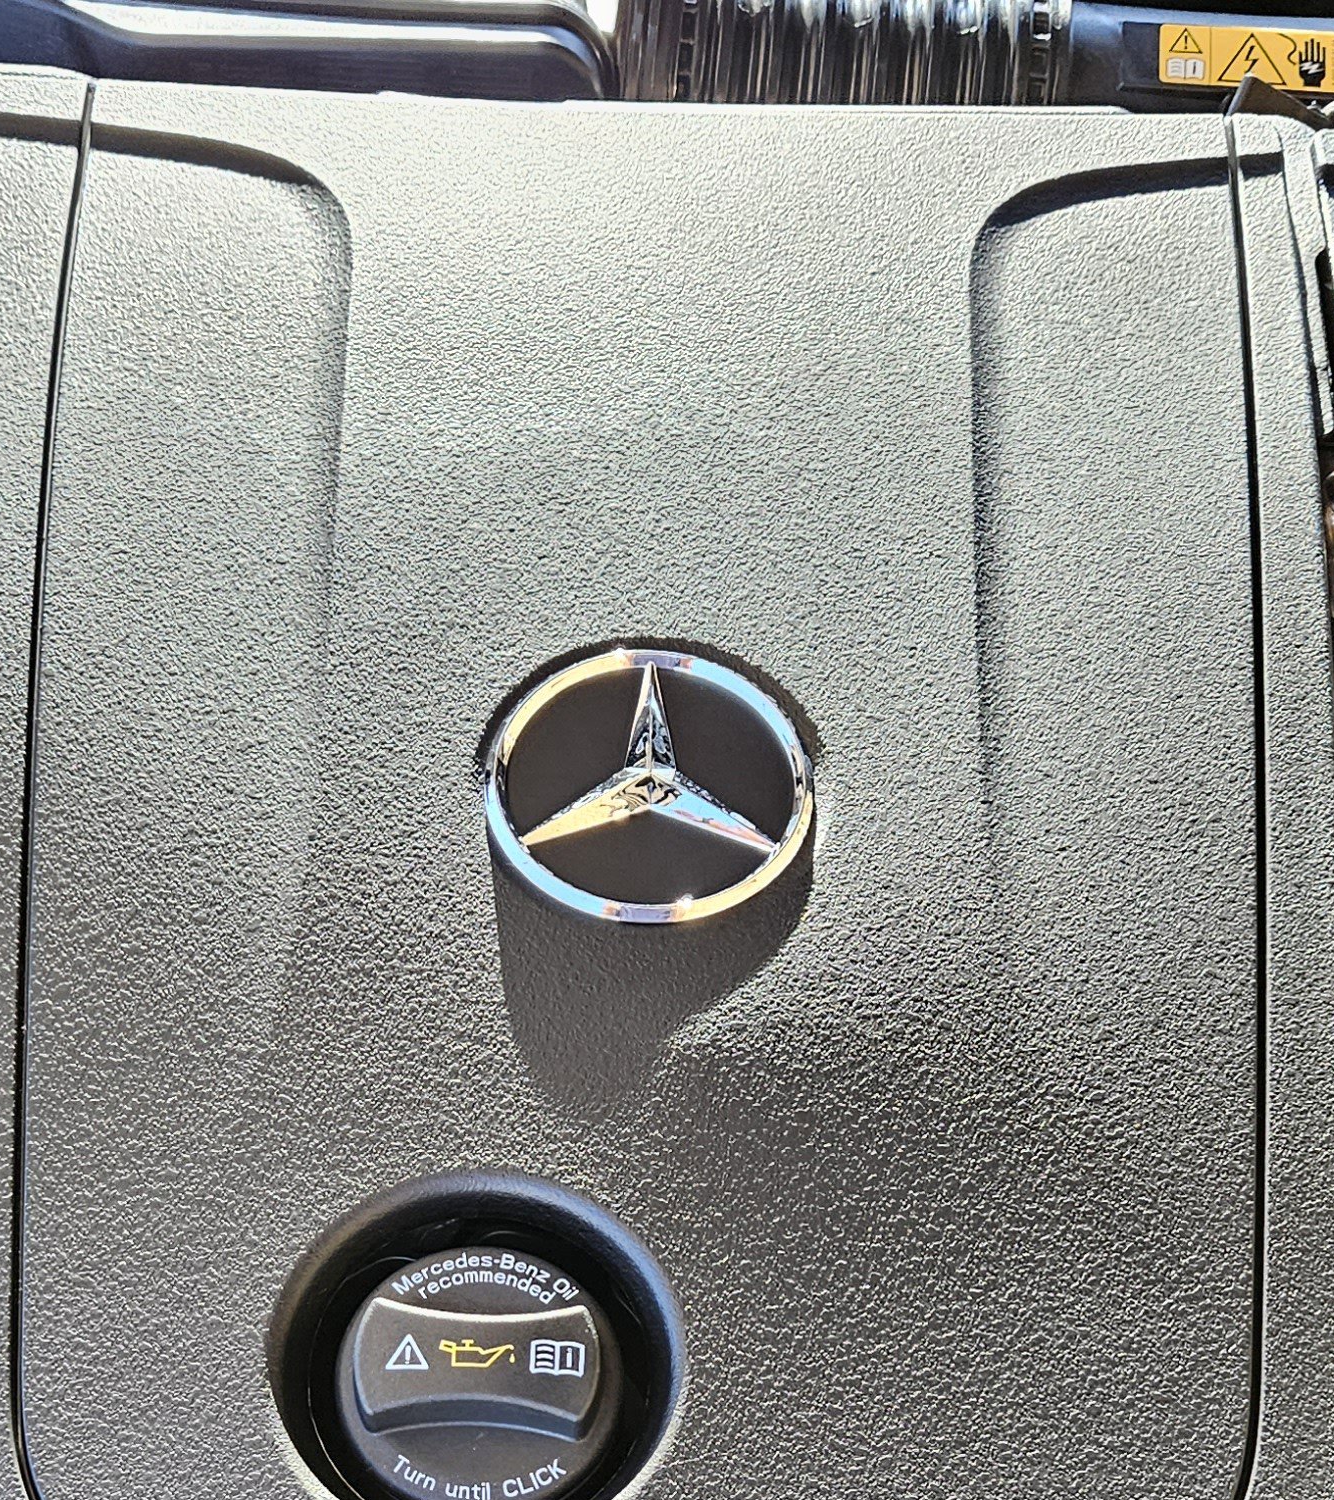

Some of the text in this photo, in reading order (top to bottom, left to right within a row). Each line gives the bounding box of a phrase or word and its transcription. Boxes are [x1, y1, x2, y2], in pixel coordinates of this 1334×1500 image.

[391, 1252, 580, 1302] Mercedes-Benz Oil
[417, 1269, 557, 1305] recommended
[392, 1454, 437, 1491] Turn
[502, 1458, 568, 1499] CLICK
